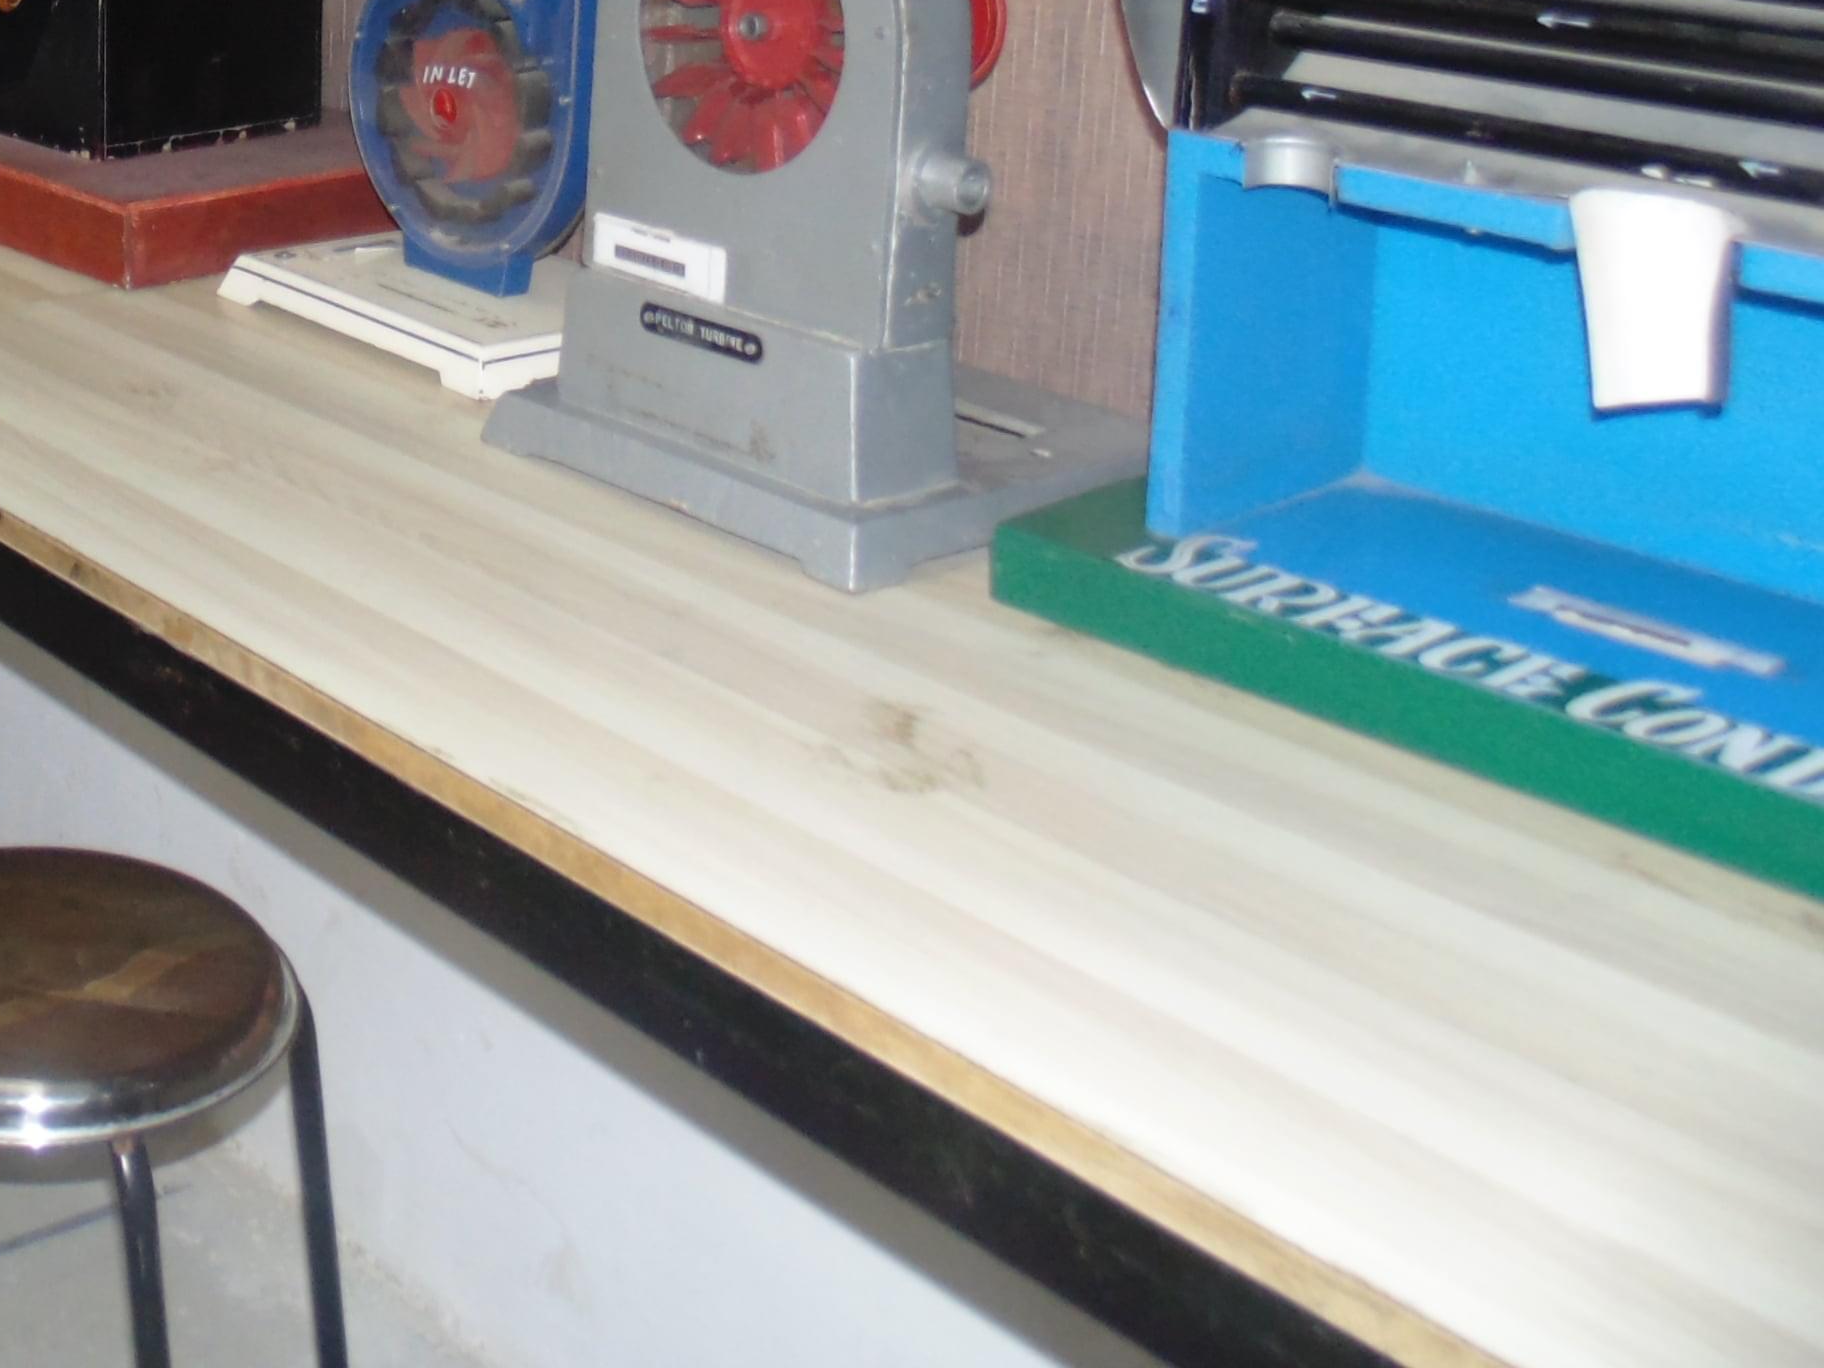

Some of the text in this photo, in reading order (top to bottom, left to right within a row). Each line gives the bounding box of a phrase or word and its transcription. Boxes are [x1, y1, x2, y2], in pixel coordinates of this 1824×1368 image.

[656, 312, 745, 353] PELTON TURBINE
[1115, 534, 1585, 698] SURFACE
